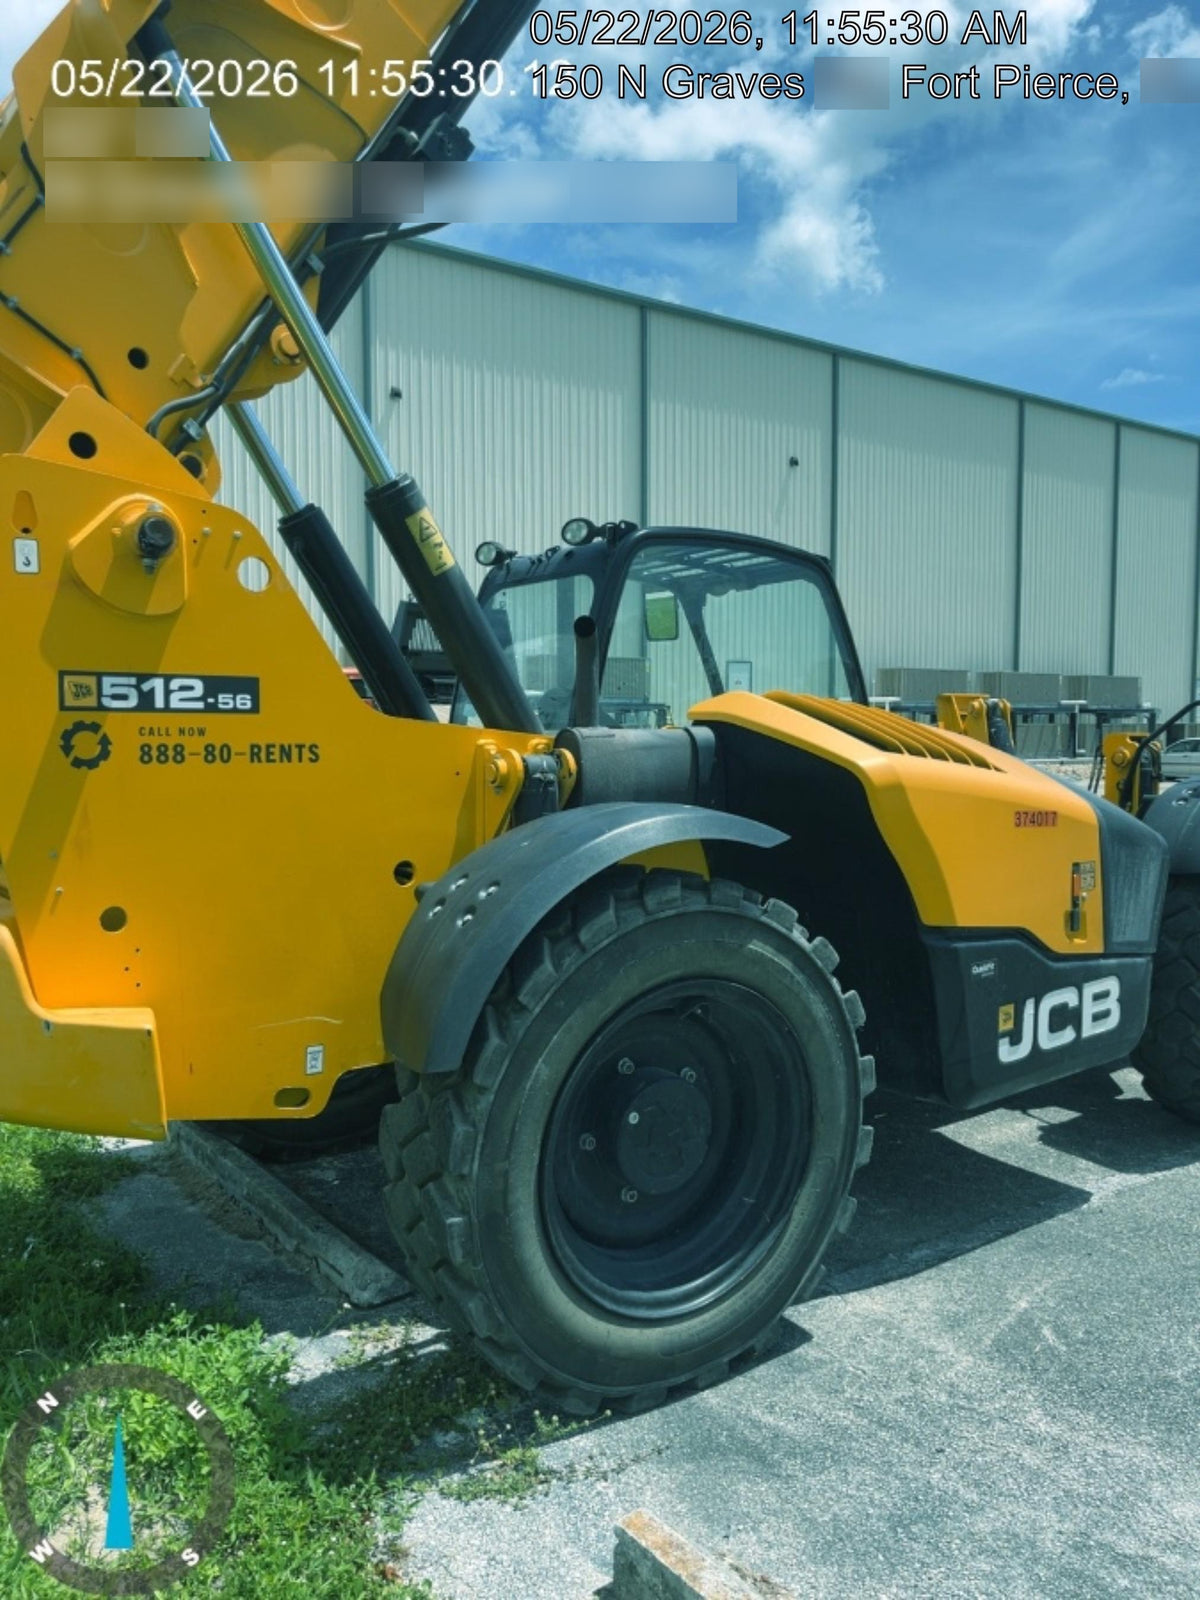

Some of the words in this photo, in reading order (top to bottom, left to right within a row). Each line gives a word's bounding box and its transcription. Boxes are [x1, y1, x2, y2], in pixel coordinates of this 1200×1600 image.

[101, 676, 252, 709] 512-56
[138, 726, 172, 737] CALL
[178, 727, 207, 738] NOW
[1014, 810, 1057, 828] 374017
[998, 975, 1121, 1063] JCB
